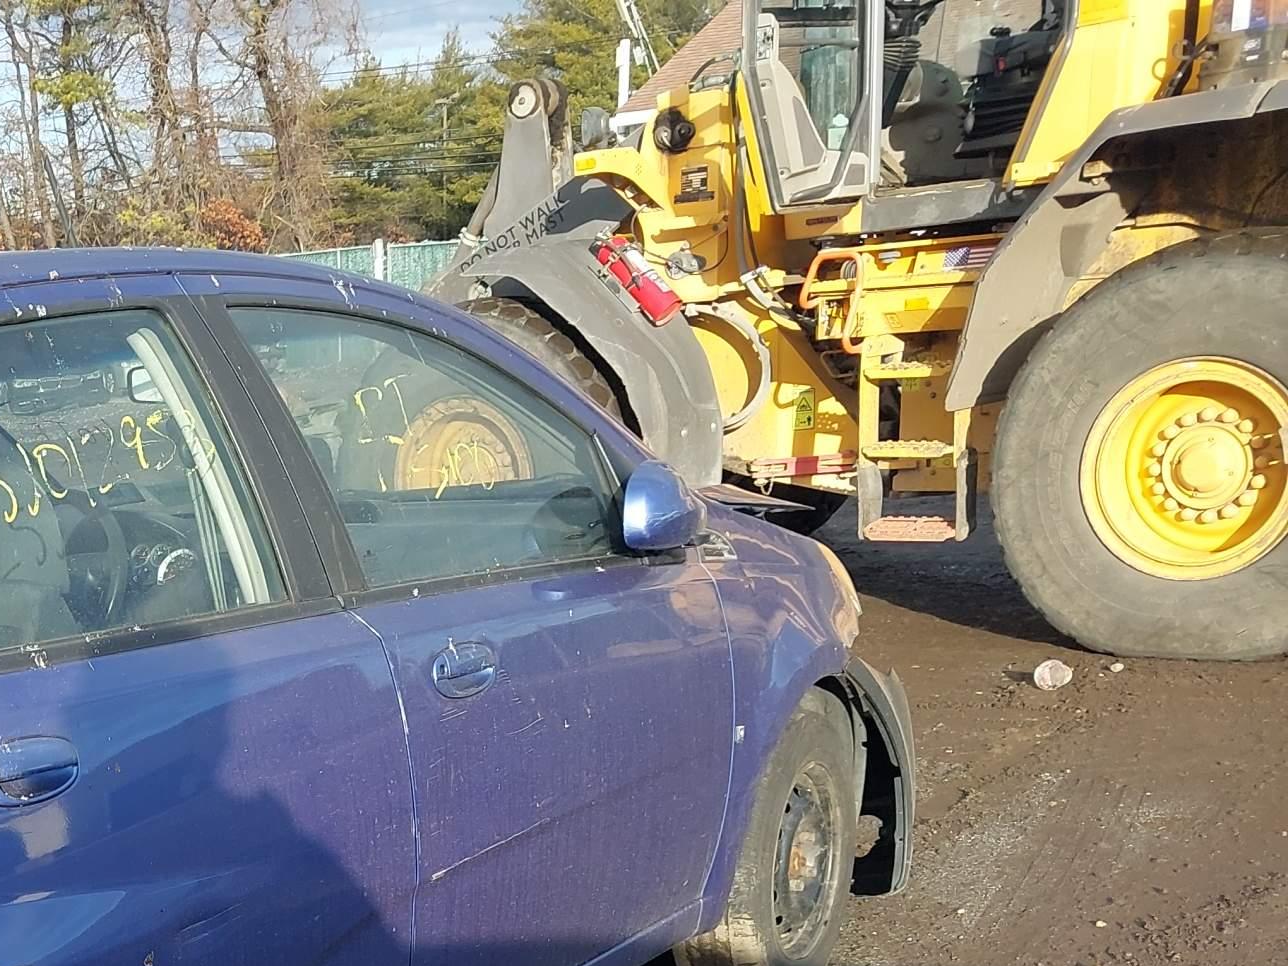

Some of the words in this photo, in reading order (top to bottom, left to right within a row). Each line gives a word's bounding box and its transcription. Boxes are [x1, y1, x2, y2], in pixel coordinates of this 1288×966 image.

[485, 226, 516, 255] NOT
[519, 192, 569, 231] WALK
[525, 208, 565, 245] MAST
